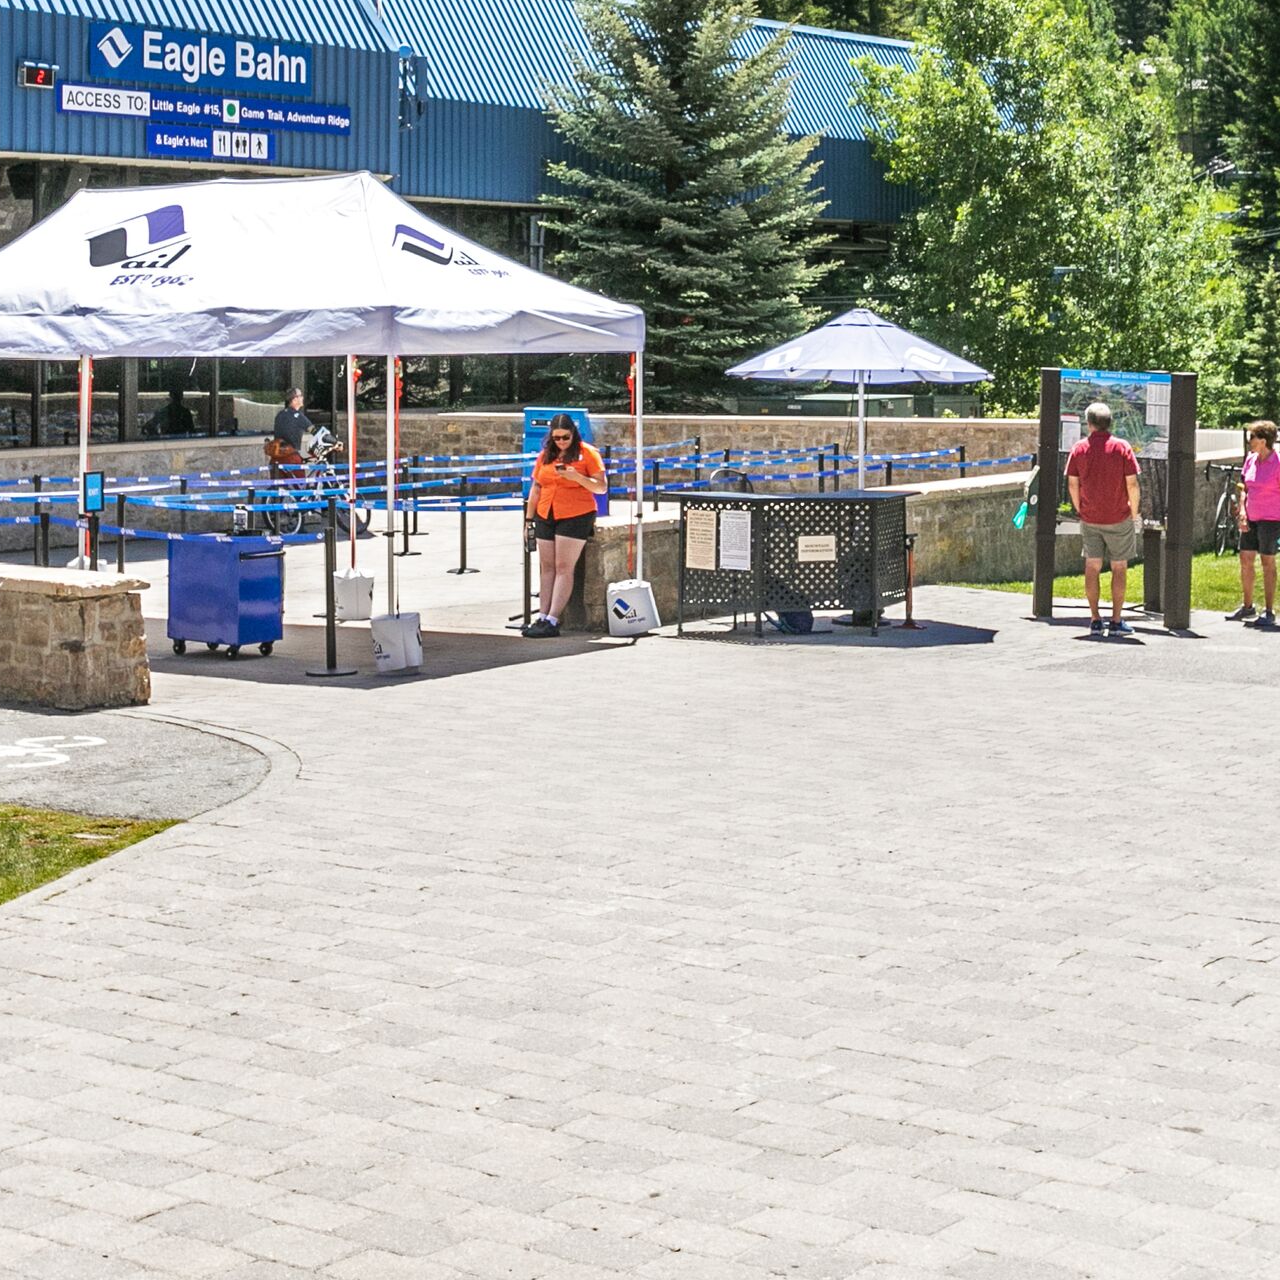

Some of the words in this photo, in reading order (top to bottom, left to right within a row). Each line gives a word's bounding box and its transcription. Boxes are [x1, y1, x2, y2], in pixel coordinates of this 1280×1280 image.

[143, 29, 226, 84] Eagle
[235, 40, 307, 84] Bahn
[36, 70, 45, 83] 2
[66, 90, 121, 109] ACCESS
[126, 95, 147, 111] TO:
[152, 99, 174, 112] Little
[176, 101, 200, 115] Eagle
[204, 104, 221, 117] #15,
[241, 107, 265, 120] Game
[267, 109, 285, 122] Trail,
[287, 111, 325, 125] Adventure
[328, 115, 350, 128] Ridge
[155, 133, 162, 145] &
[163, 134, 189, 148] Eagle's
[191, 136, 208, 148] Nest
